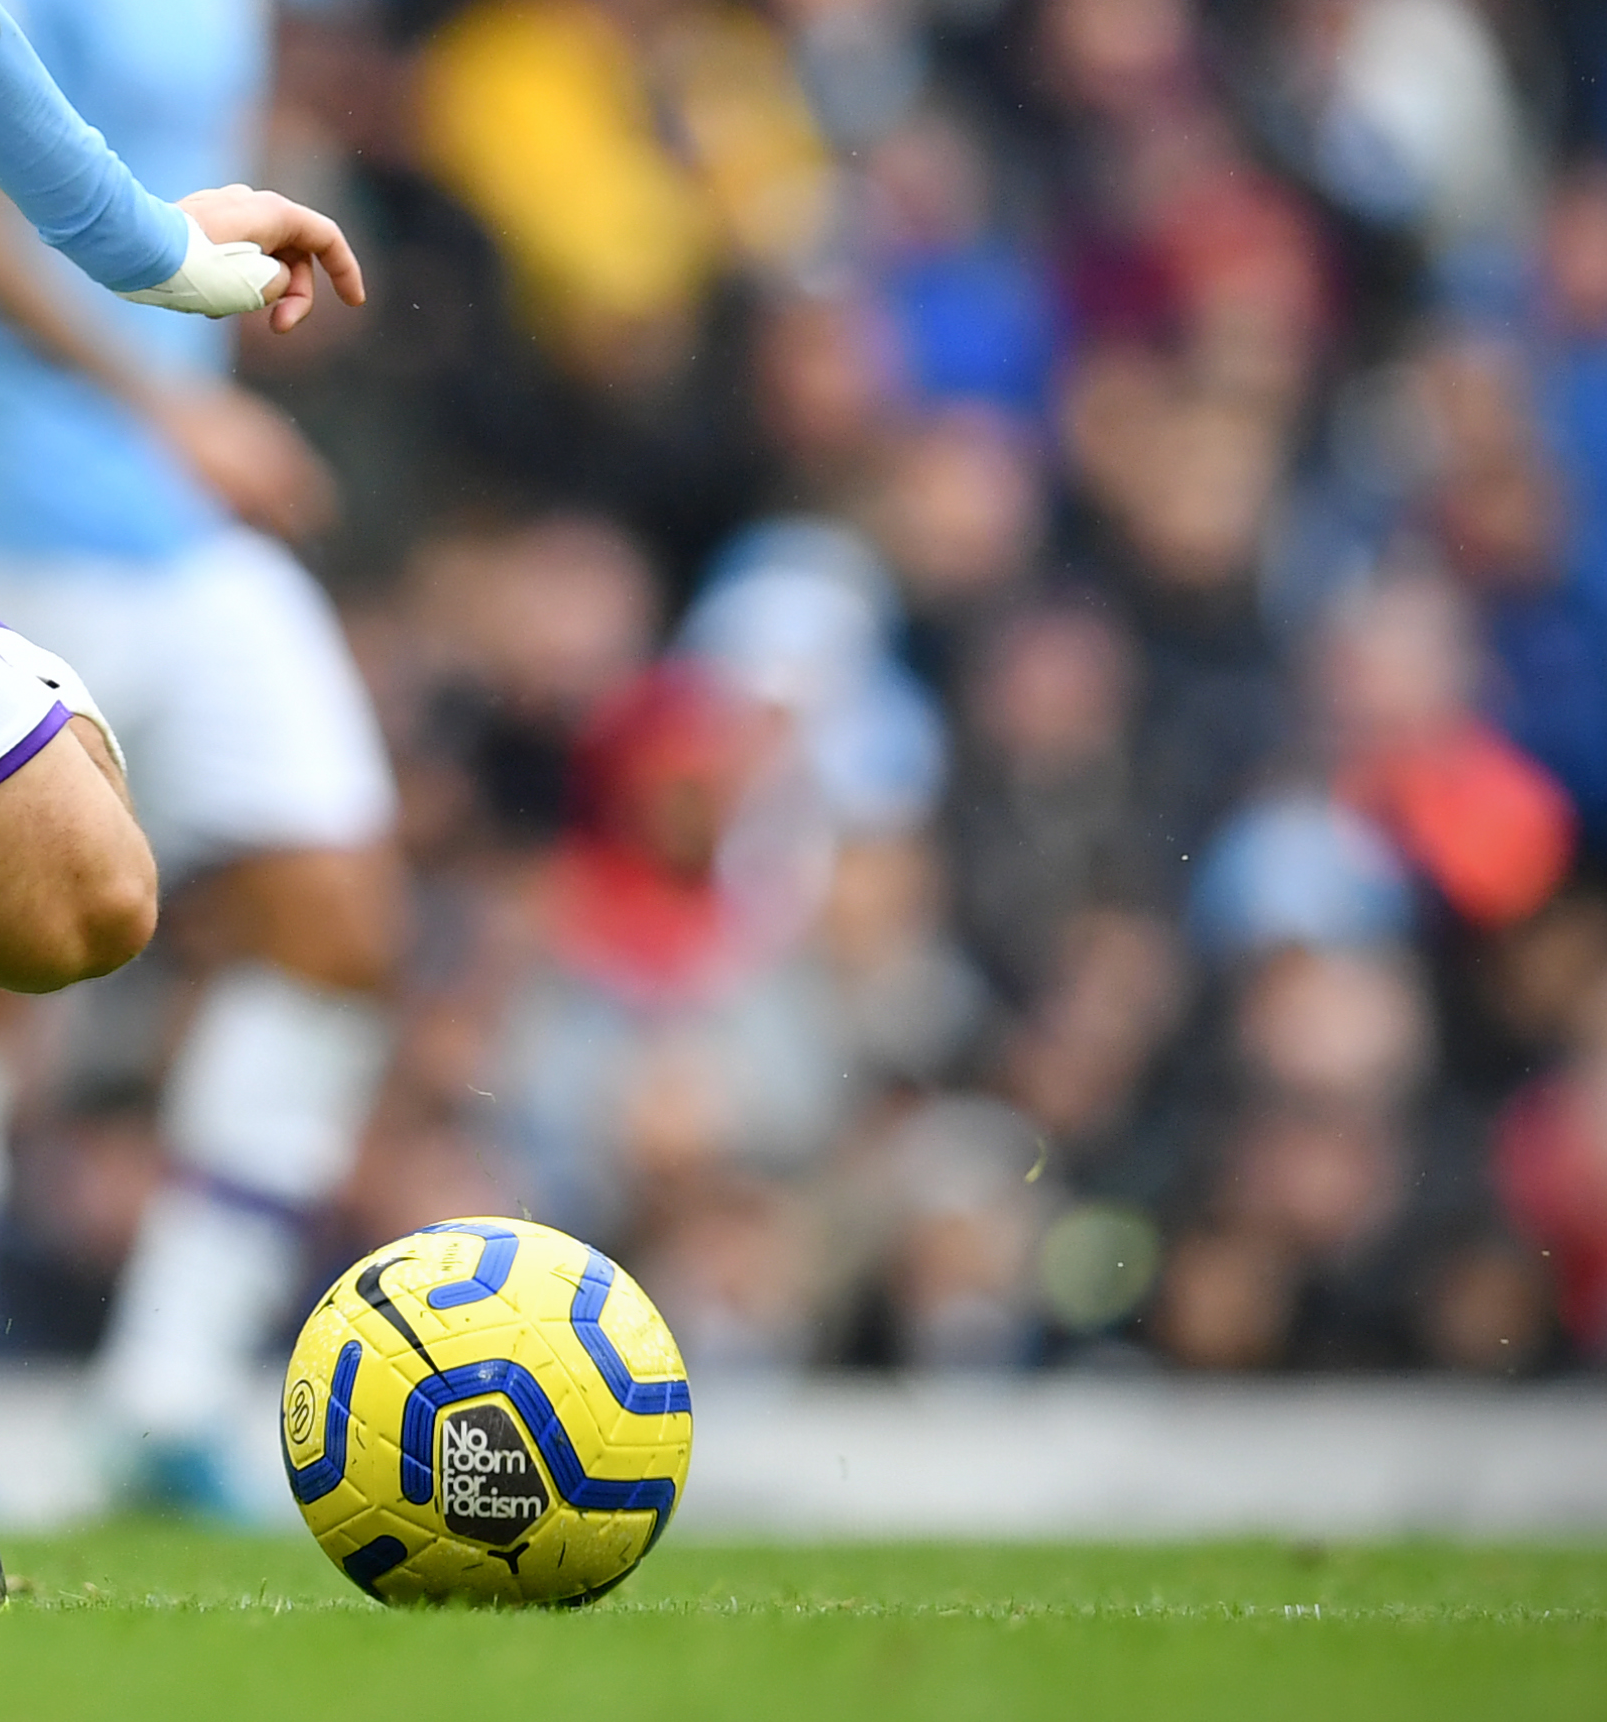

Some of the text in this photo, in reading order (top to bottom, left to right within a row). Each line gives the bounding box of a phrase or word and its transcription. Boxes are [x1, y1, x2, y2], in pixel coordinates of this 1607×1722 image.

[442, 1419, 488, 1452] No
[442, 1447, 526, 1474] room
[442, 1467, 487, 1498] for
[442, 1486, 542, 1519] racism
